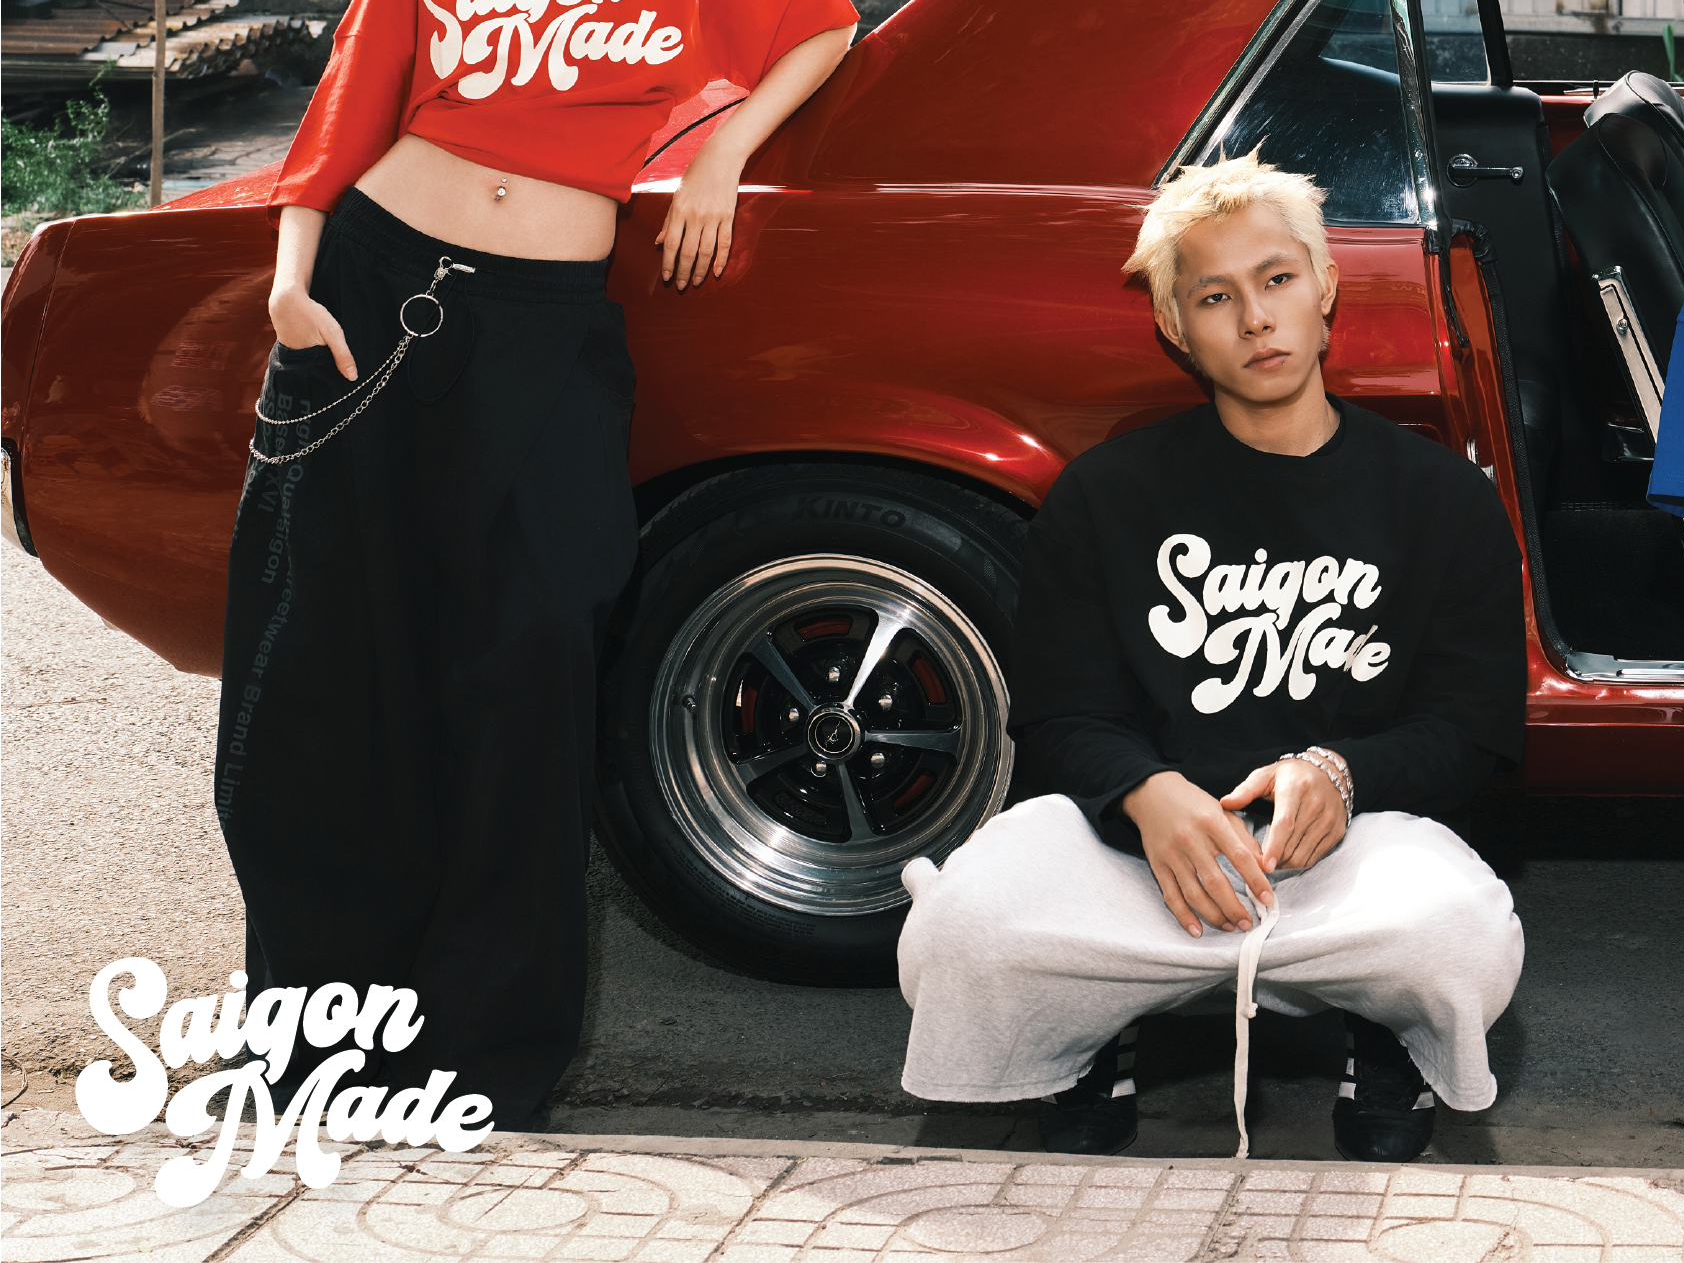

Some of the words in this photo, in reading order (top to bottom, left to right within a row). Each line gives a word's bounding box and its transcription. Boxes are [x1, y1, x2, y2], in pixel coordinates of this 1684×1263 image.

[458, 4, 684, 99] Made
[791, 497, 907, 528] KINTO
[1148, 534, 1382, 658] Saigon
[229, 684, 262, 757] Brand
